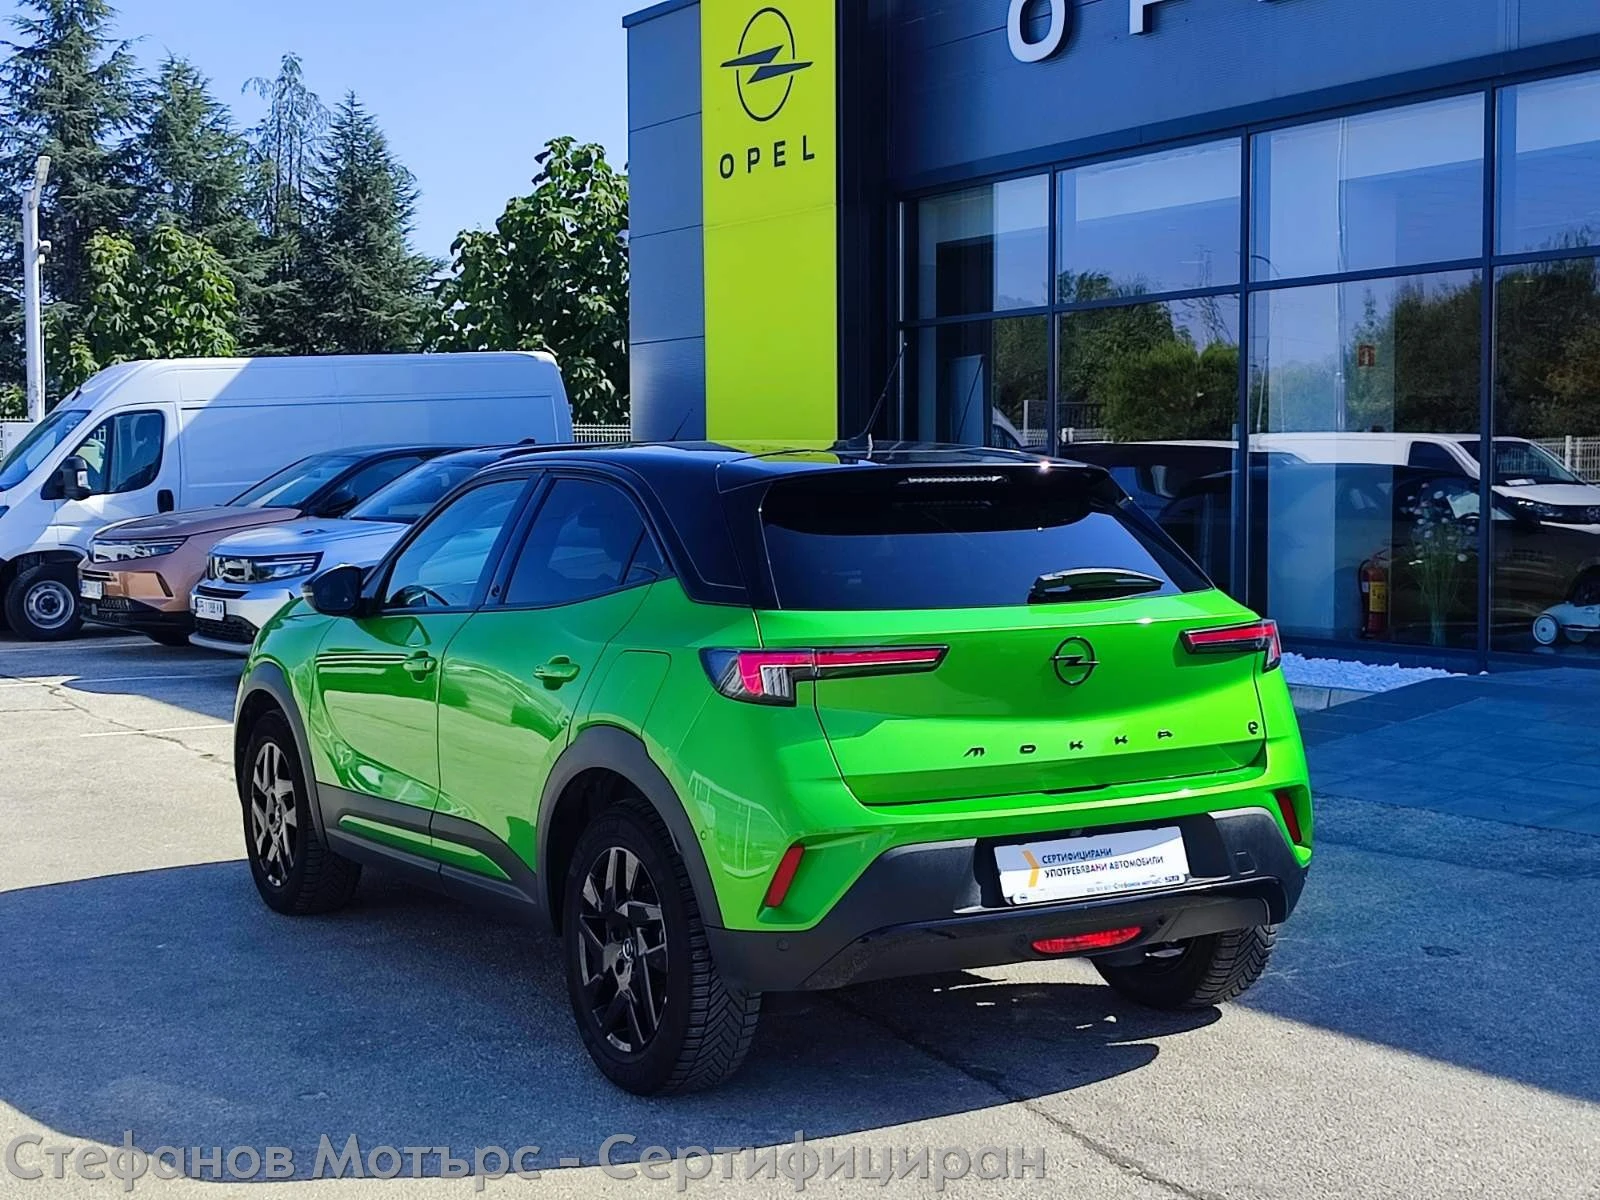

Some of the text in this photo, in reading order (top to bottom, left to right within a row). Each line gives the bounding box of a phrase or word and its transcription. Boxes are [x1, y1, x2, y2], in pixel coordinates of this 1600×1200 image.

[719, 134, 815, 179] OPEL
[963, 729, 1173, 758] MOKKA
[1042, 848, 1112, 864] СЕРТИФИЦИРАНИ
[1044, 856, 1164, 879] УПОТРЕБЯВАНИ АВТОМОБИЛИ
